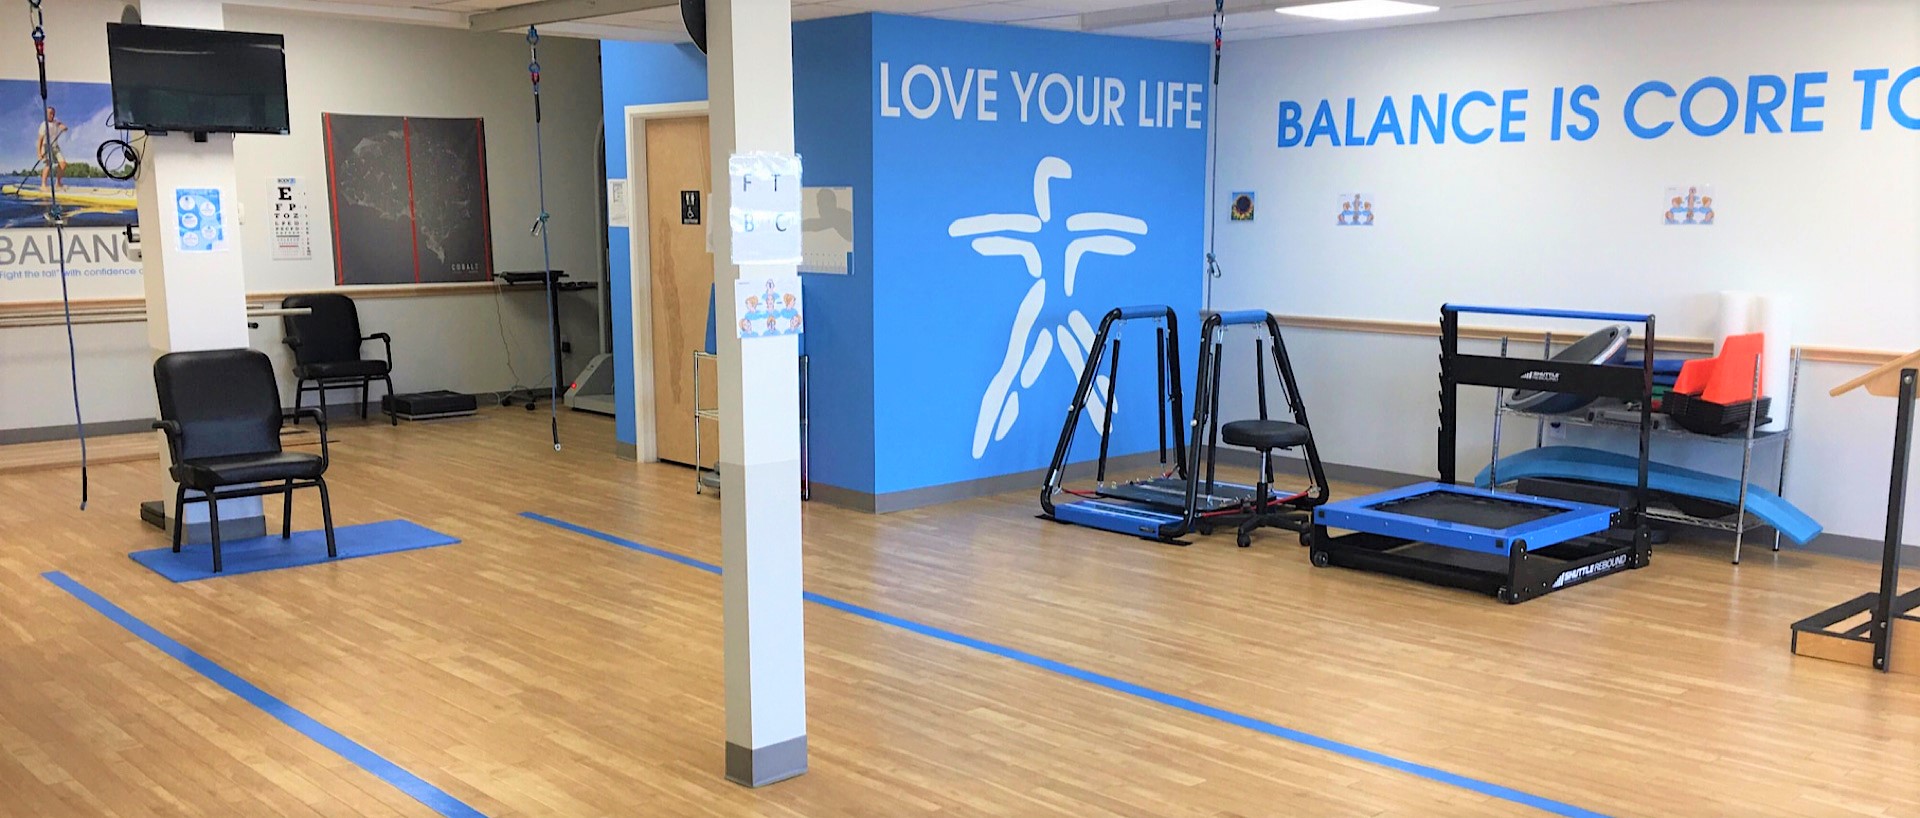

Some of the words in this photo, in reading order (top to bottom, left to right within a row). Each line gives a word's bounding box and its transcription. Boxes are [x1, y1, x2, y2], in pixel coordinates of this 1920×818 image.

[880, 62, 997, 121] LOVE
[1010, 70, 1126, 126] YOUR
[1139, 79, 1203, 129] LIFE
[1277, 89, 1529, 148] BALANCE
[1551, 84, 1600, 141] IS
[1623, 71, 1828, 139] CORE
[1853, 65, 1920, 131] TO
[743, 173, 752, 192] F
[771, 173, 781, 192] T
[278, 186, 292, 200] E
[744, 213, 754, 232] B
[775, 213, 787, 232] C
[24, 270, 40, 279] the
[84, 267, 136, 276] confidence
[1564, 564, 1594, 581] SHUTTLE
[1594, 554, 1627, 572] REBOUND
